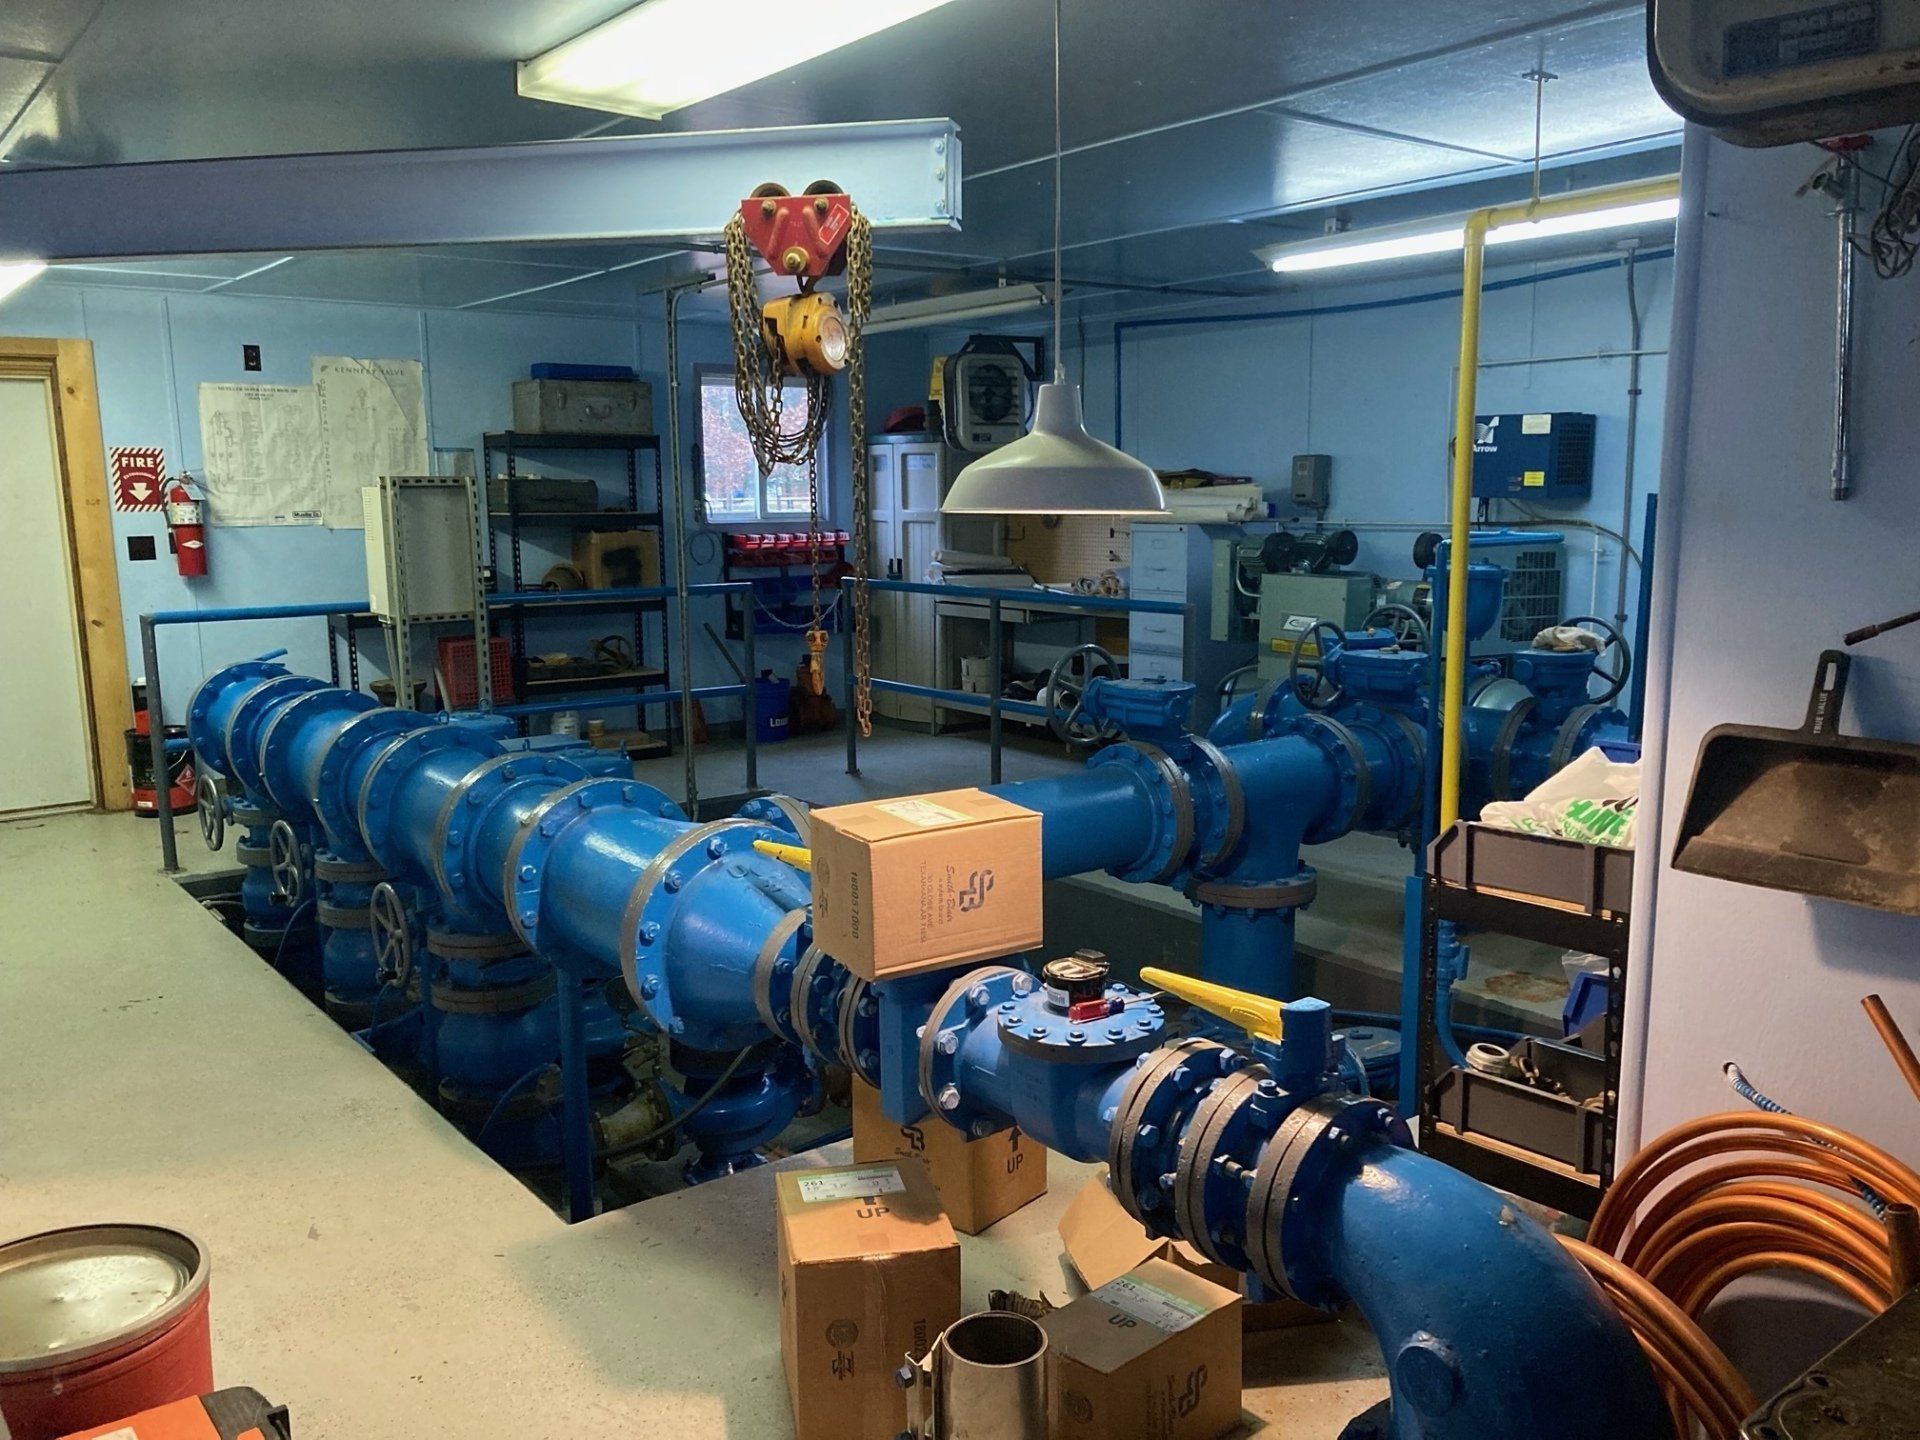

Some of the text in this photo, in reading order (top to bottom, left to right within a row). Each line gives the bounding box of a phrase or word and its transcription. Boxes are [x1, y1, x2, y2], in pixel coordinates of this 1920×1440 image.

[121, 457, 155, 467] FIRE
[1813, 692, 1828, 733] TRUE VALUE
[1007, 1153, 1024, 1174] UP
[856, 1207, 890, 1219] UP
[1108, 1314, 1137, 1328] UP
